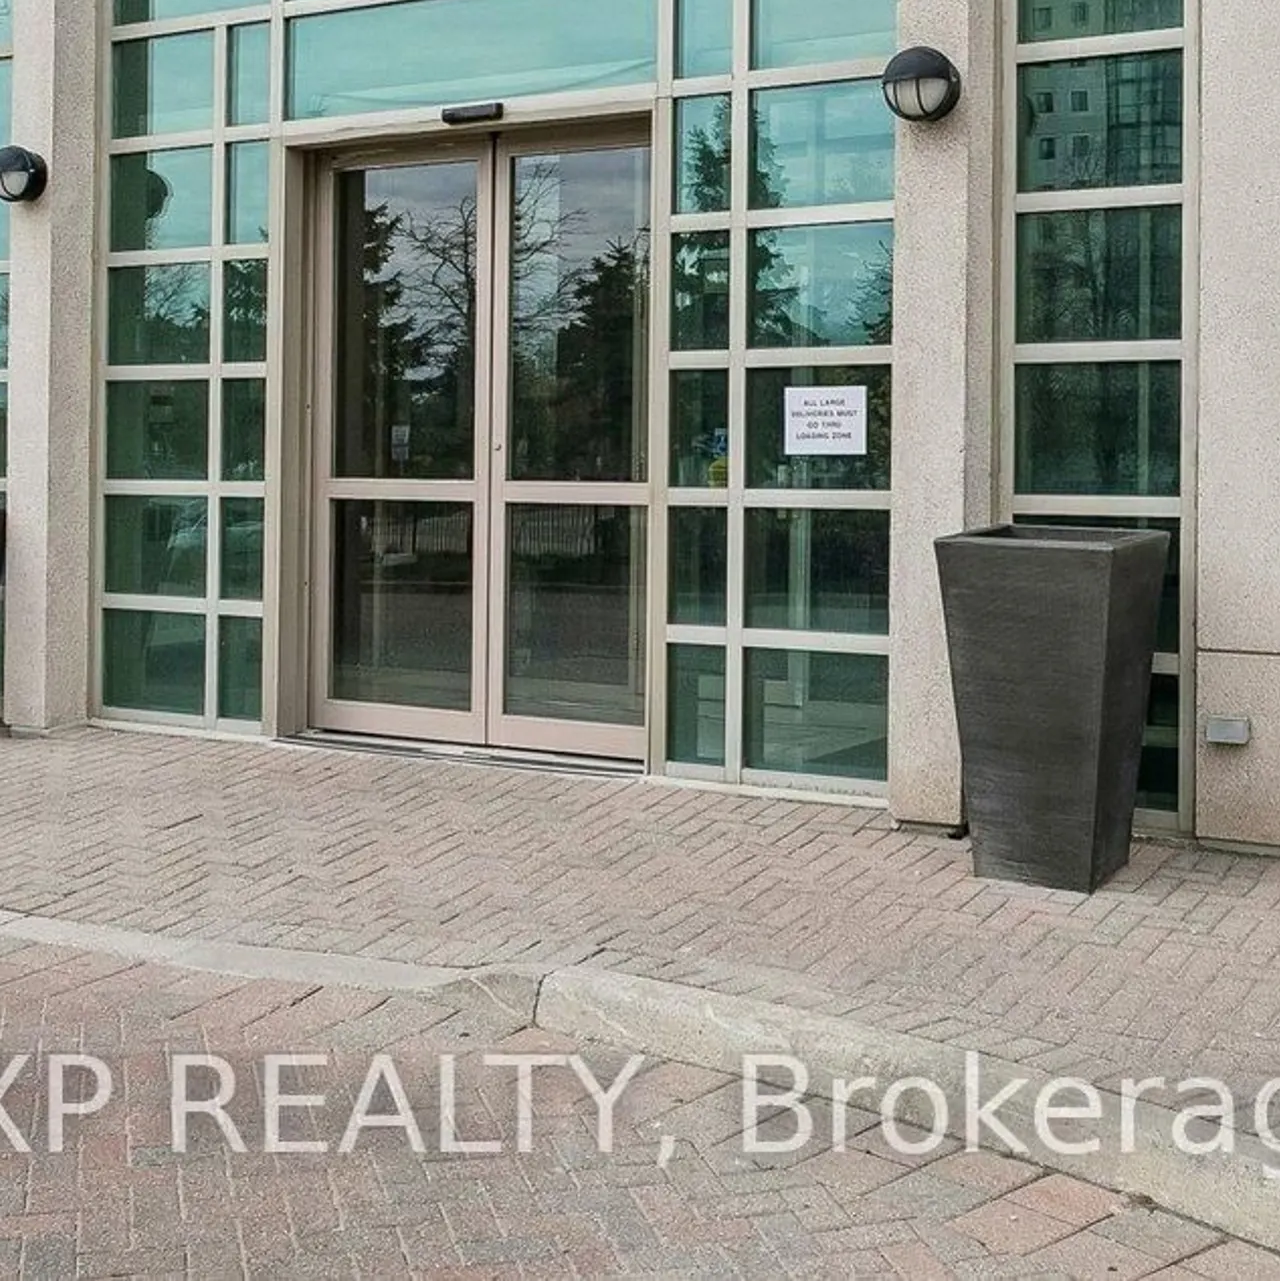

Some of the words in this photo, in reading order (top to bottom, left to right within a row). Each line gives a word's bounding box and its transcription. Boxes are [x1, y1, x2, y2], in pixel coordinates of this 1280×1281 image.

[803, 399, 817, 407] ALL
[820, 399, 845, 407] LARGE
[836, 409, 858, 417] MUST
[806, 421, 818, 429] GO
[796, 432, 829, 440] LOADING
[832, 431, 852, 439] ZONE
